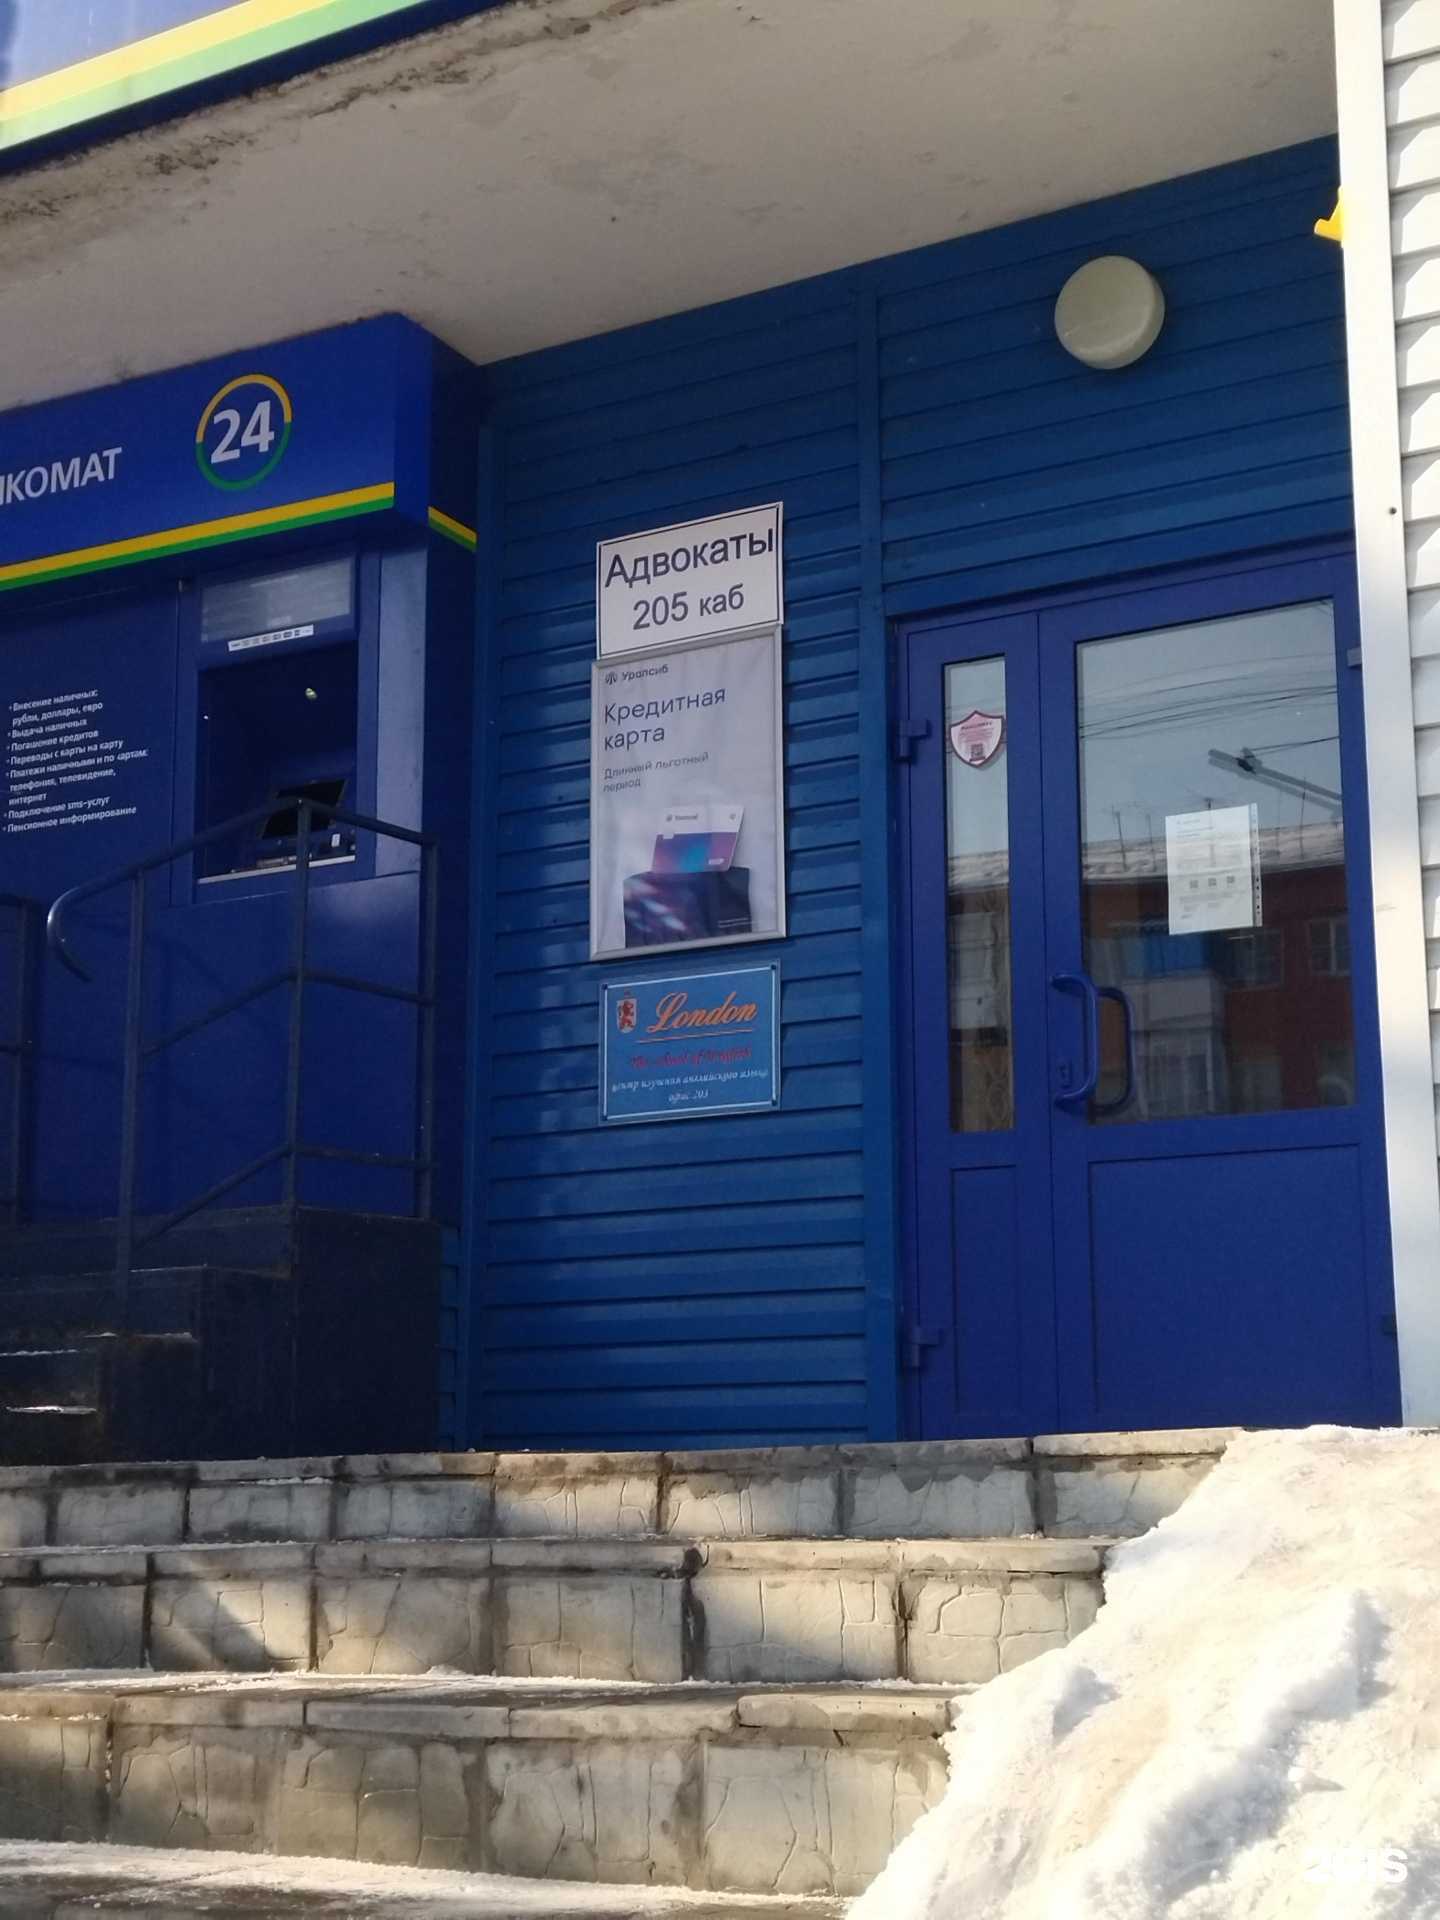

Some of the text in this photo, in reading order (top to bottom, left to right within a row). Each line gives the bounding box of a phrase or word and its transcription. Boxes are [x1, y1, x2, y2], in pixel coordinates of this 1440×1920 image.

[210, 399, 275, 464] 24
[605, 528, 773, 588] Адвокаты
[633, 583, 745, 630] 205 каб
[622, 664, 669, 681] Уралсиб
[82, 702, 103, 715] евро
[605, 688, 726, 725] Кредитная
[12, 725, 43, 738] Выдача
[59, 730, 99, 744] кредитов
[604, 727, 665, 751] карта
[10, 750, 53, 766] Переводы
[60, 745, 86, 759] карты
[100, 739, 124, 752] карту
[104, 755, 114, 764] по
[603, 752, 709, 780] Длинный льготный
[603, 778, 641, 793] период
[8, 803, 66, 819] Подключение
[9, 792, 47, 806] интернет
[8, 807, 137, 832] Пенсионное информирование
[646, 991, 758, 1033] London
